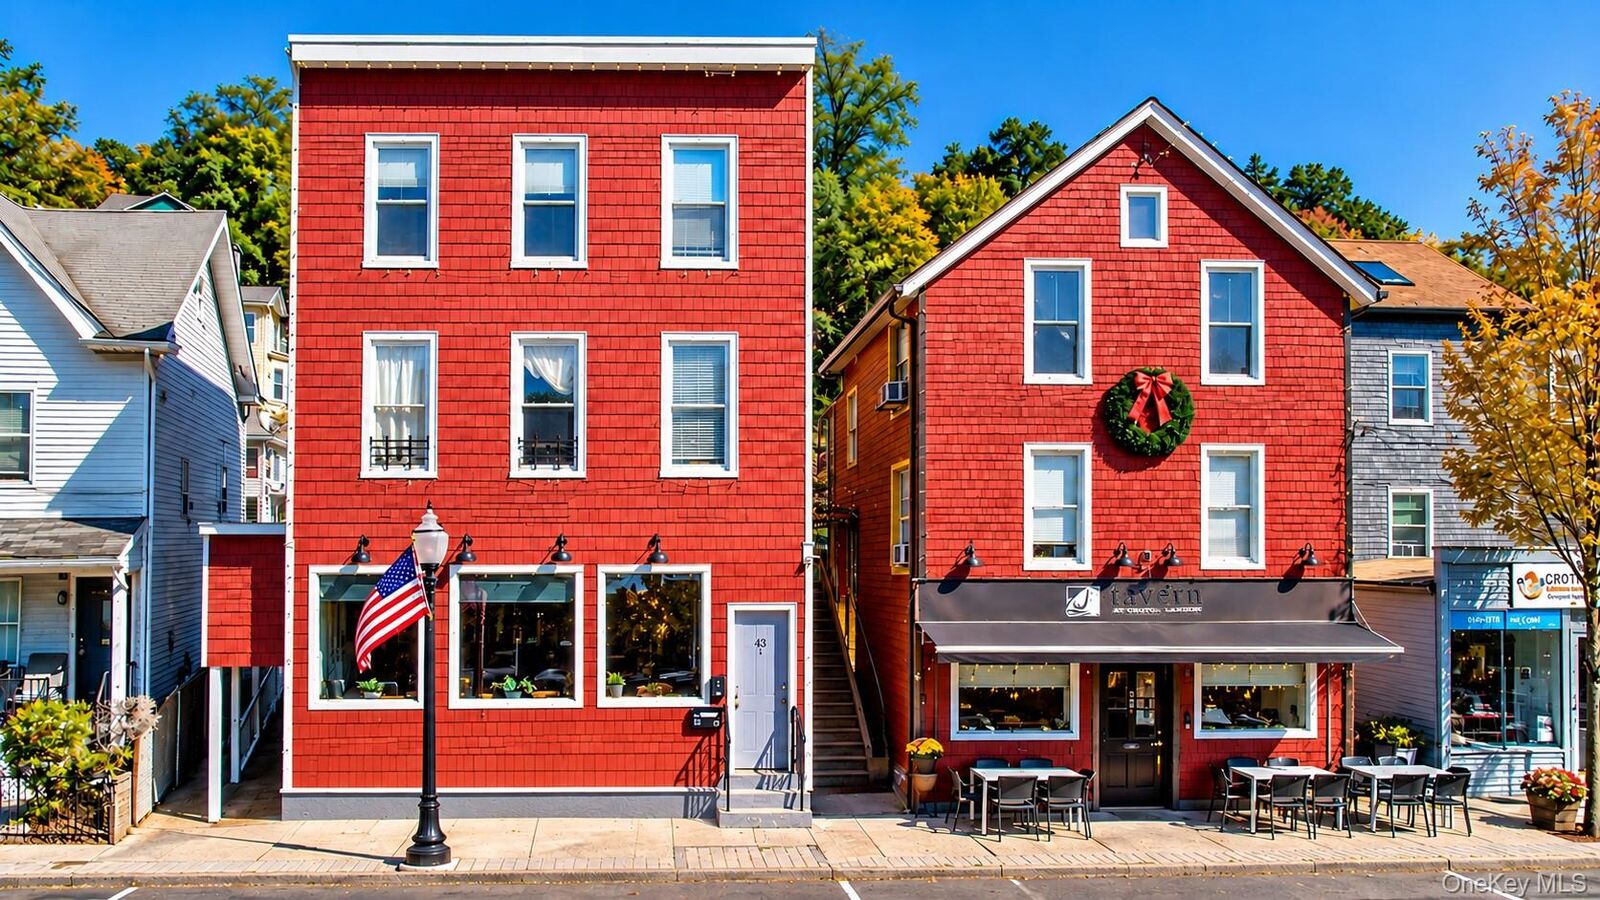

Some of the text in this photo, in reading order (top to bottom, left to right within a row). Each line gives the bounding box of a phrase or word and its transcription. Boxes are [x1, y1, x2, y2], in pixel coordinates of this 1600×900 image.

[1545, 573, 1579, 585] CROT
[1111, 584, 1202, 606] tavern
[754, 638, 767, 648] 43
